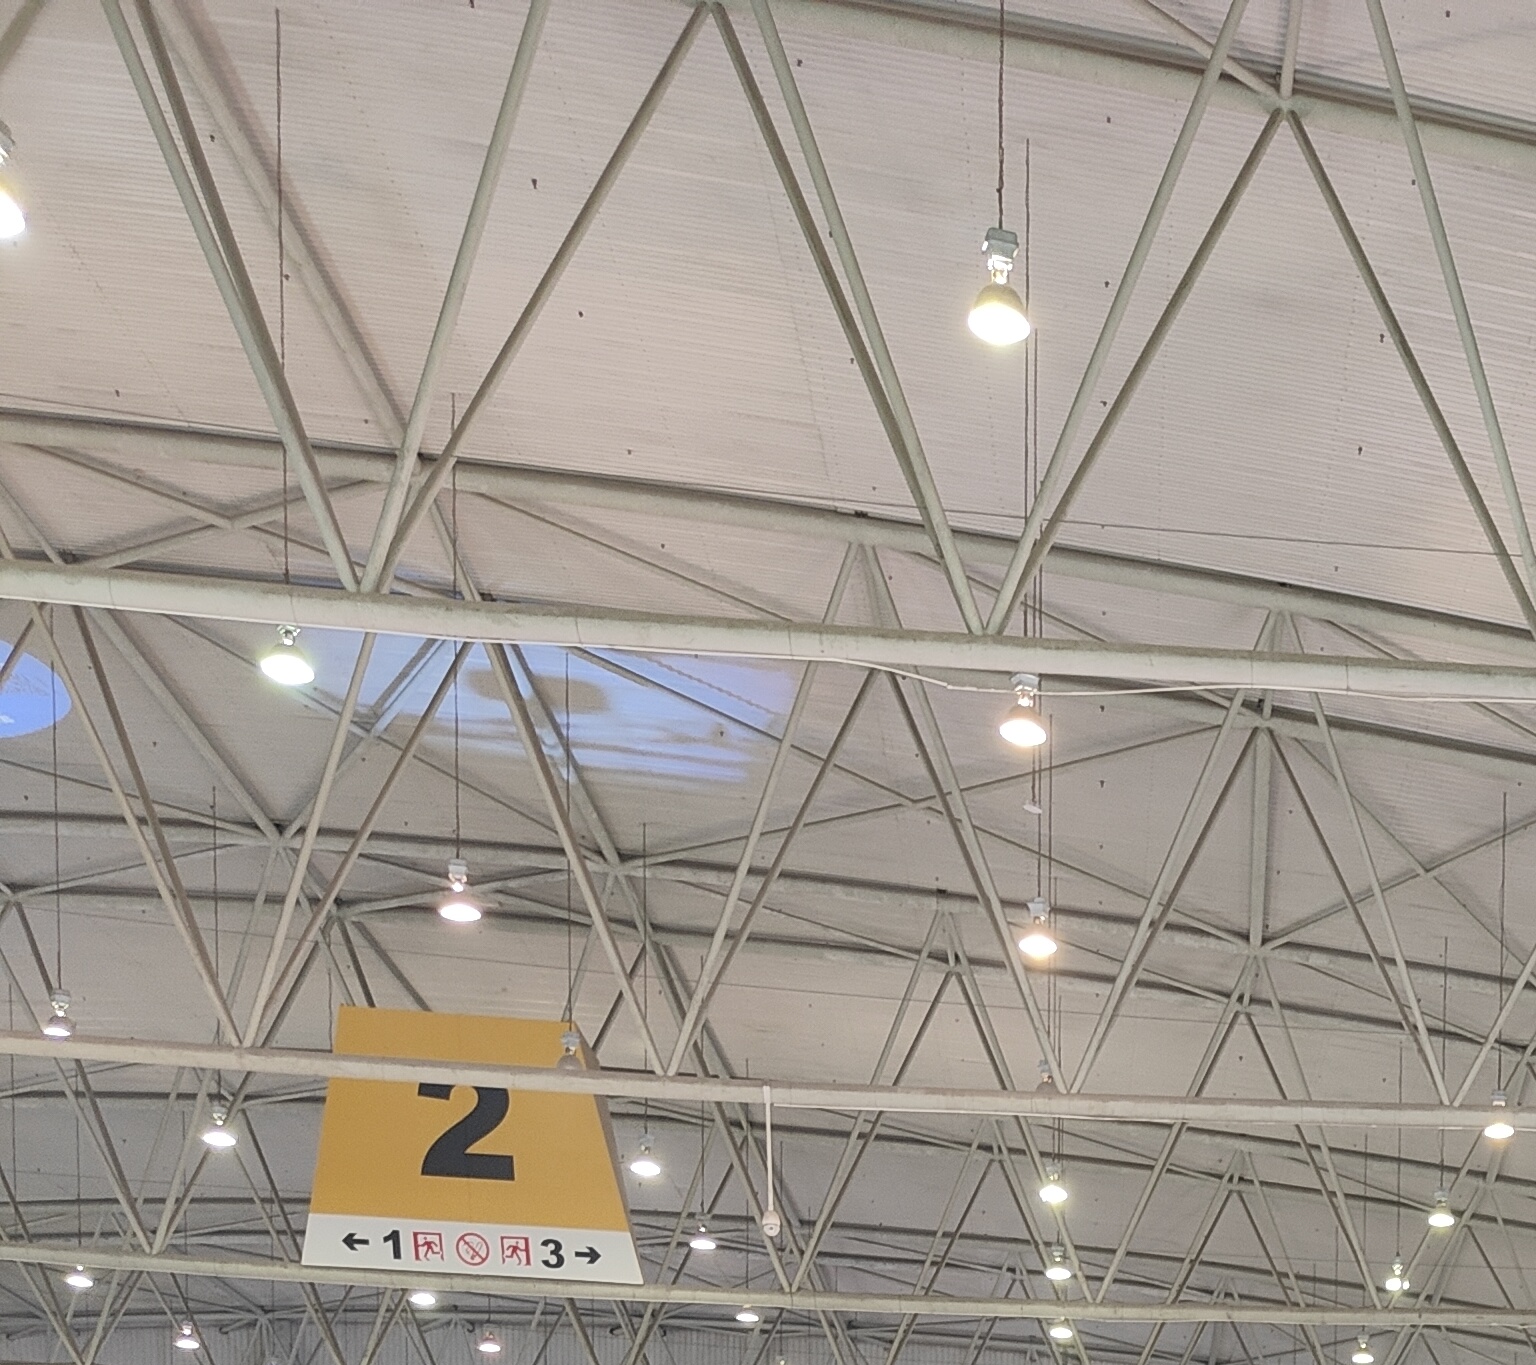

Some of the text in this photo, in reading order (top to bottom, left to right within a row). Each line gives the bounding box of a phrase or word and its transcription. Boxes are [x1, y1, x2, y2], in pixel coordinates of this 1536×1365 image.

[417, 1081, 515, 1181] 2
[383, 1230, 565, 1268] 1 3
